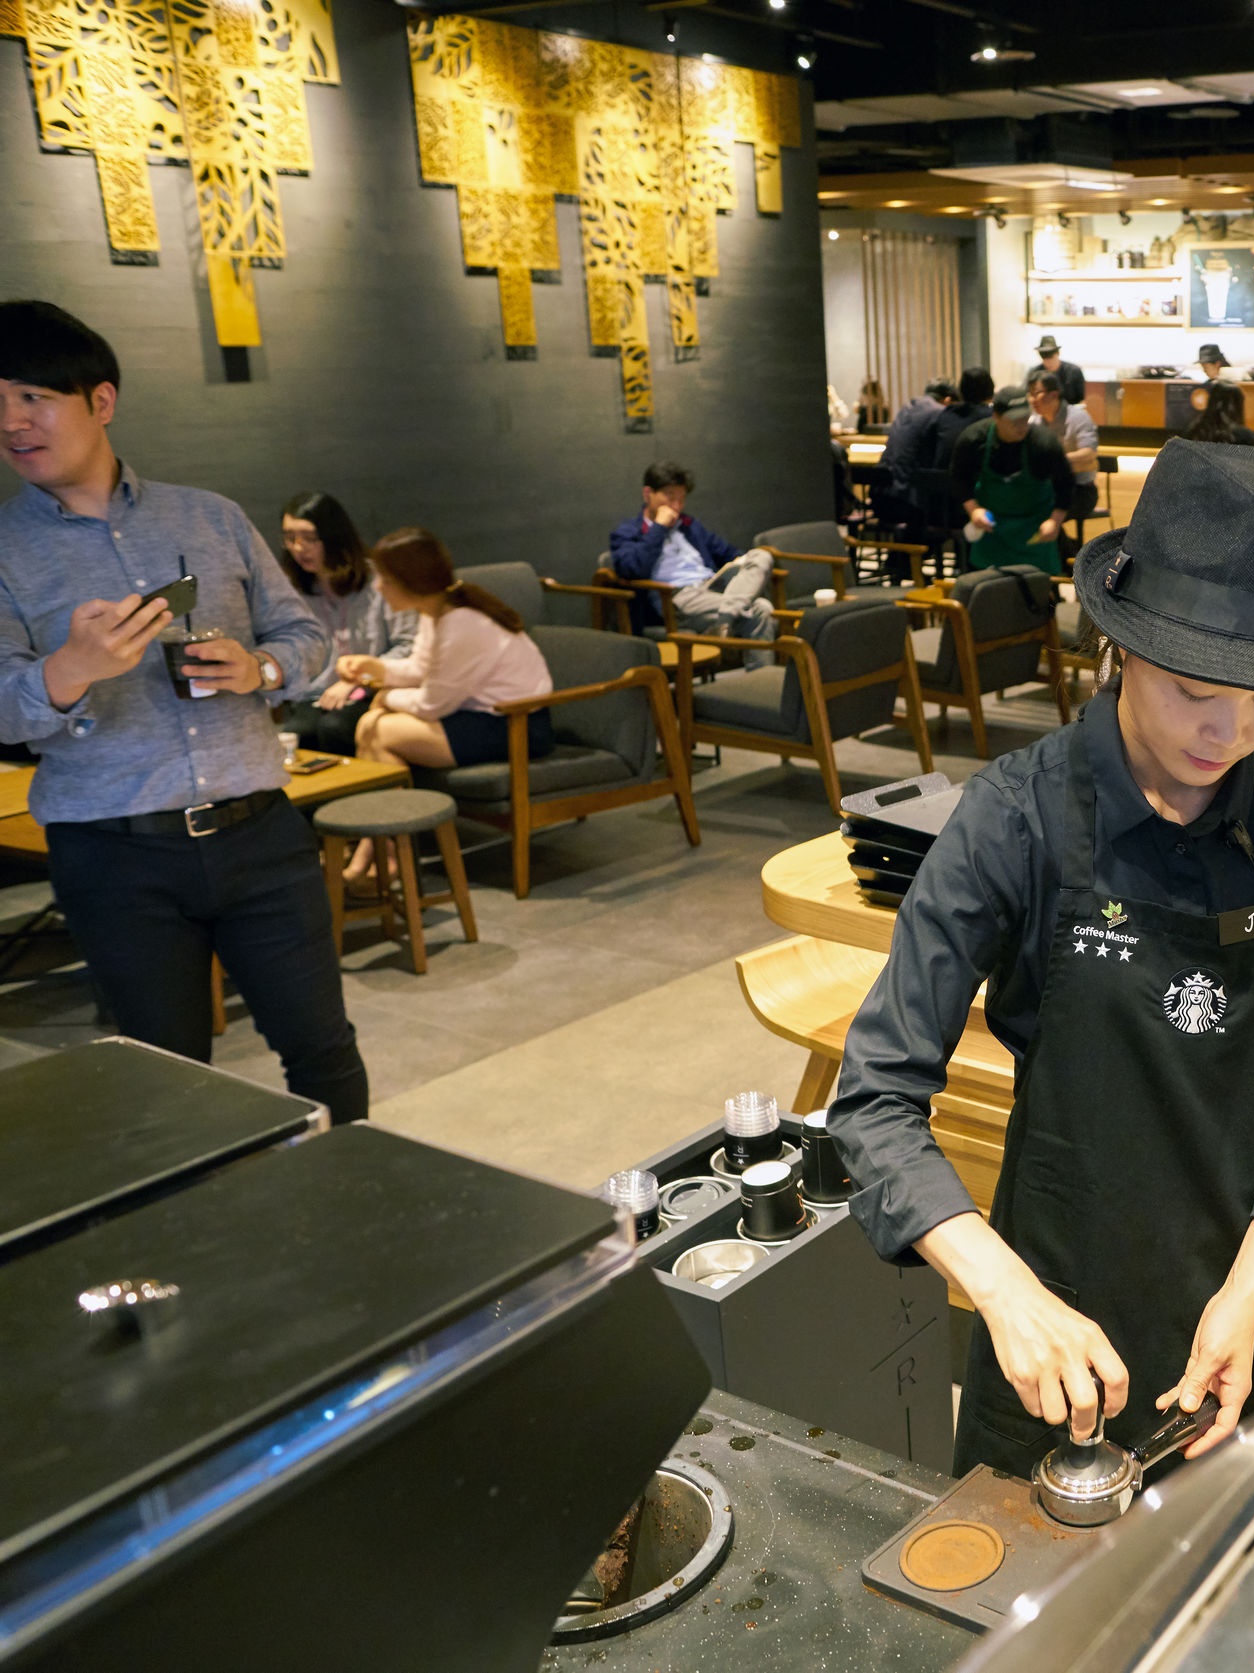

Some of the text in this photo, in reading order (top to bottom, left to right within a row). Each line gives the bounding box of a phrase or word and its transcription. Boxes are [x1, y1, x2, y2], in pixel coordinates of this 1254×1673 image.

[1073, 925, 1140, 945] Coffee Master
[1215, 1026, 1225, 1034] TM
[897, 1356, 917, 1397] R
